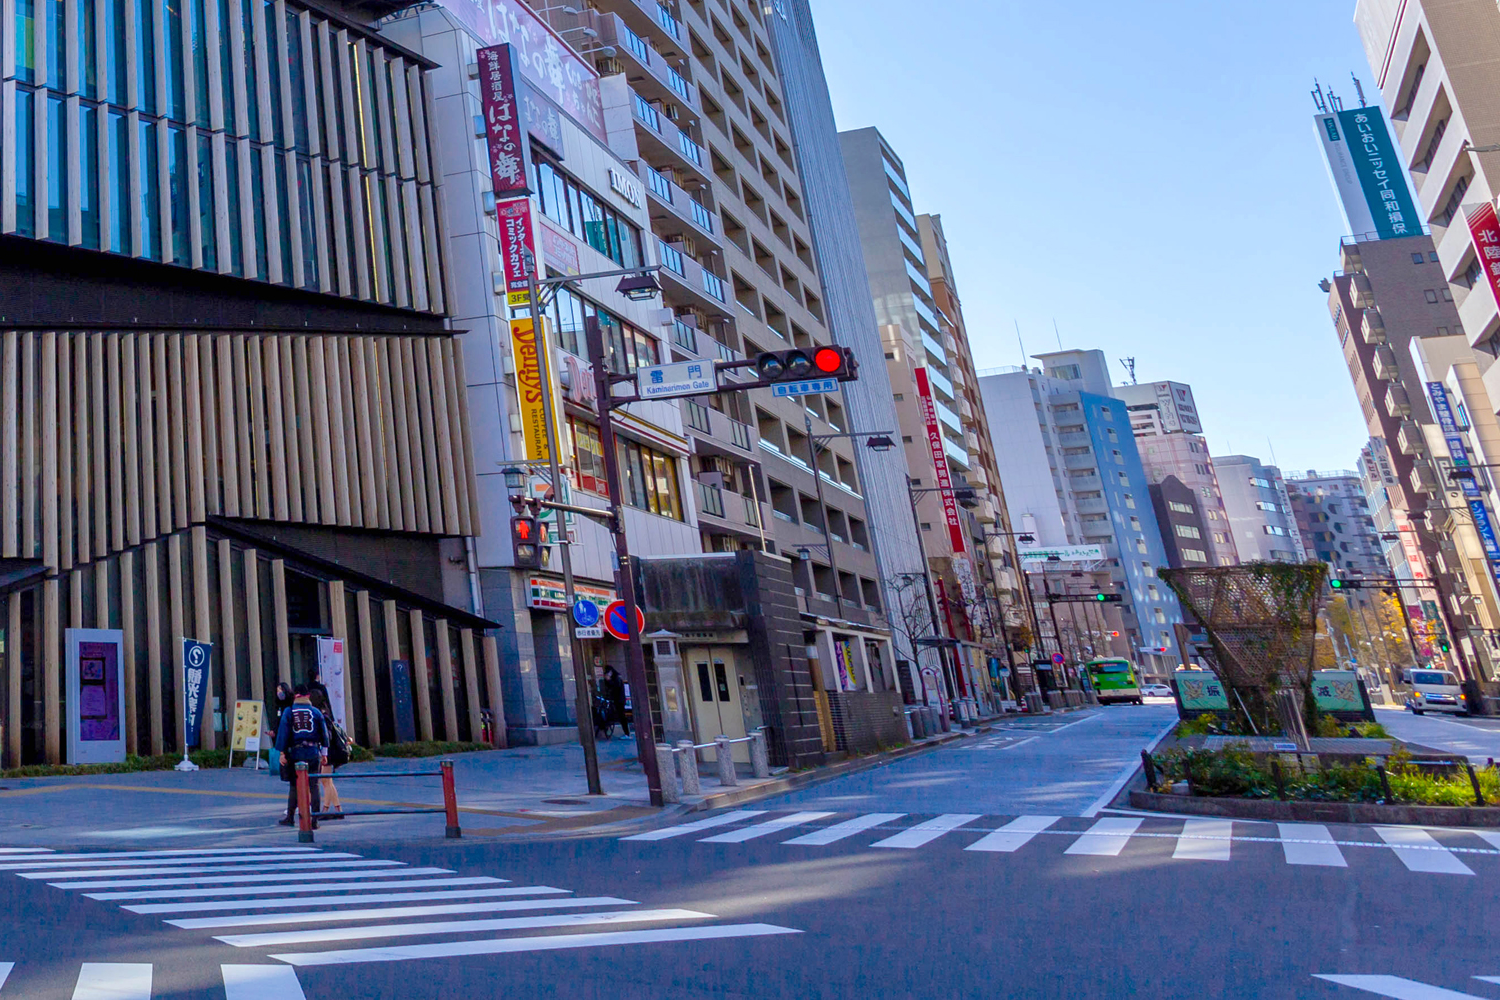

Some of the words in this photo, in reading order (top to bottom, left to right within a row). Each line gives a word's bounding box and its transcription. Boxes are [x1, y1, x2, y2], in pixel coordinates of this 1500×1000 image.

[487, 50, 506, 101] 海鮮居酒屋
[489, 102, 521, 185] はなの舞
[609, 167, 642, 209] IMON
[1354, 113, 1408, 235] あいおいニッセイ同和損保
[506, 218, 521, 278] コミックカフェ
[646, 382, 691, 394] Kaminarimon
[693, 381, 709, 389] Gate
[651, 364, 702, 384] 雷門
[777, 380, 834, 395] 自転車専用
